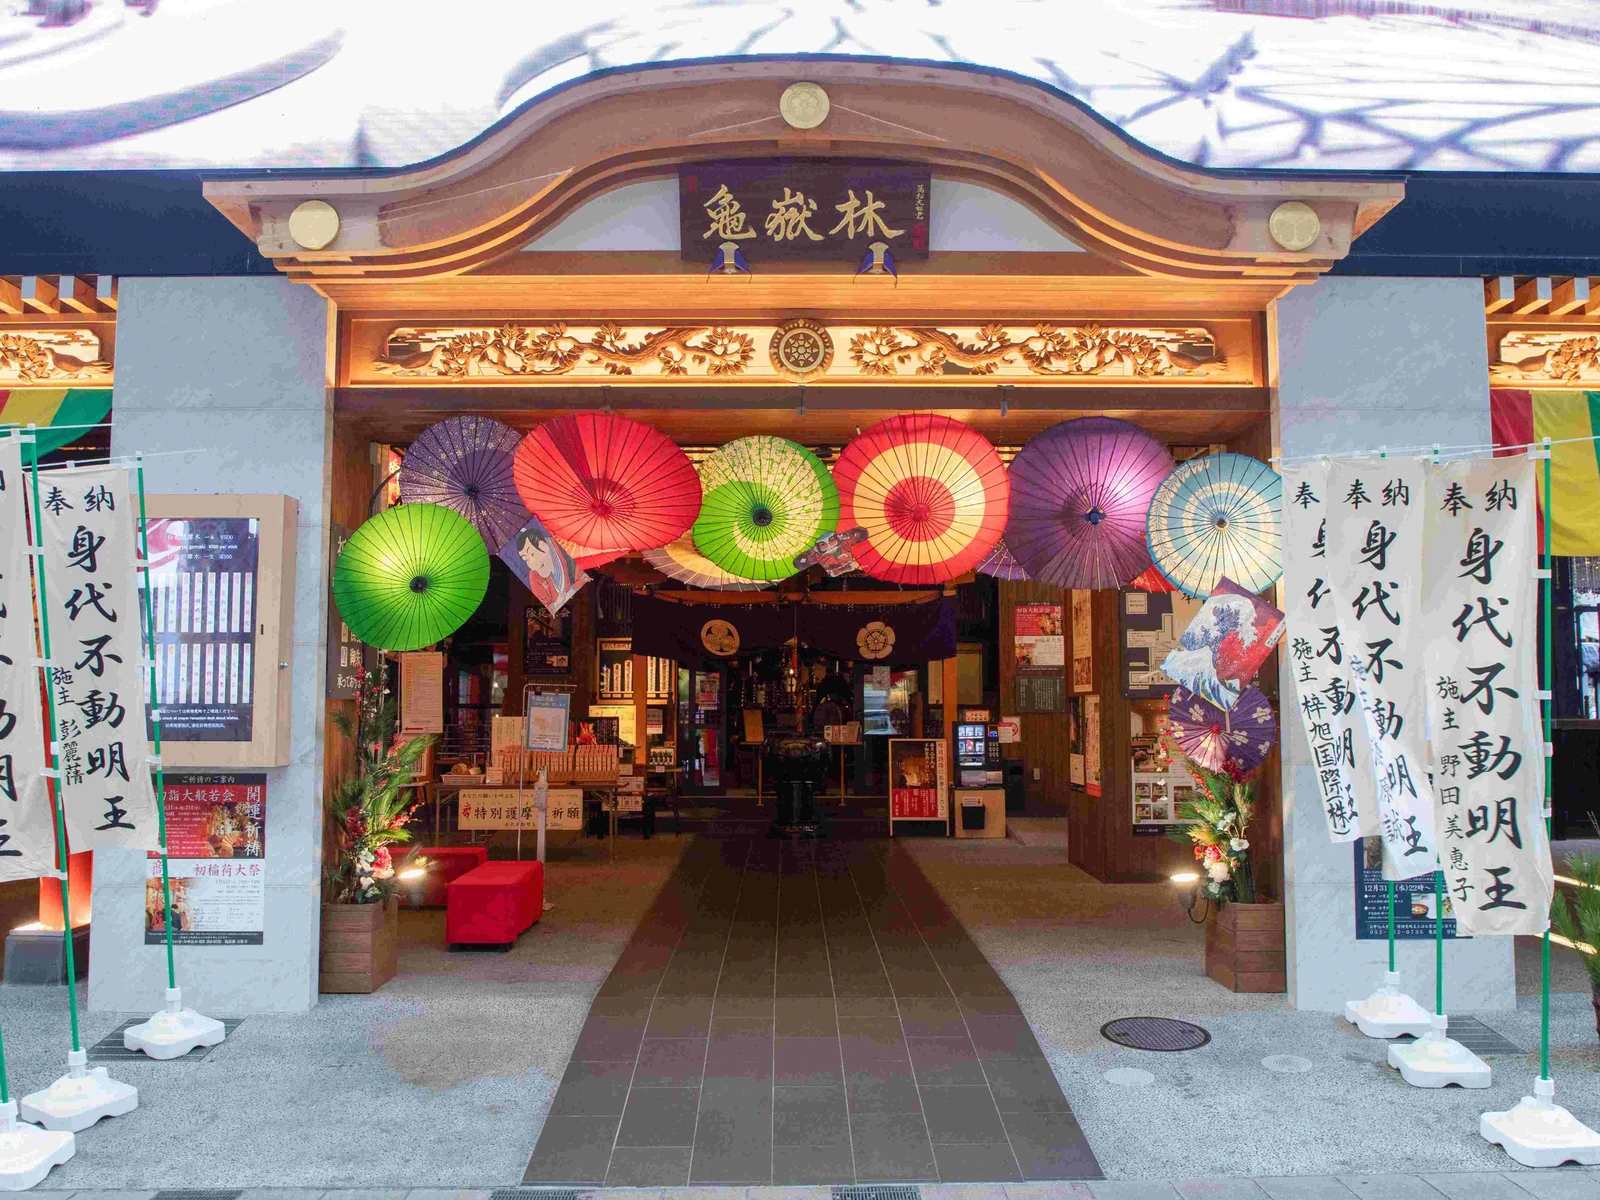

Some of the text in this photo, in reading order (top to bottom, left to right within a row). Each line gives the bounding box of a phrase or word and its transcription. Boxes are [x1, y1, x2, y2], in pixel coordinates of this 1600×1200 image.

[44, 484, 116, 517] 奉納
[1342, 478, 1410, 510] 奉納
[1439, 478, 1518, 517] 奉納
[525, 606, 572, 618] 除夜会
[64, 524, 137, 831] 身代不動明王
[1291, 637, 1318, 683] 施主
[51, 666, 76, 706] 施主
[1351, 519, 1429, 857] 身代不動明王
[1435, 675, 1461, 731] 施主
[1451, 526, 1527, 912] 身代不動明王
[474, 806, 580, 821] 特別護摩祈願
[1364, 884, 1431, 892] 12月31(水)22時〜
